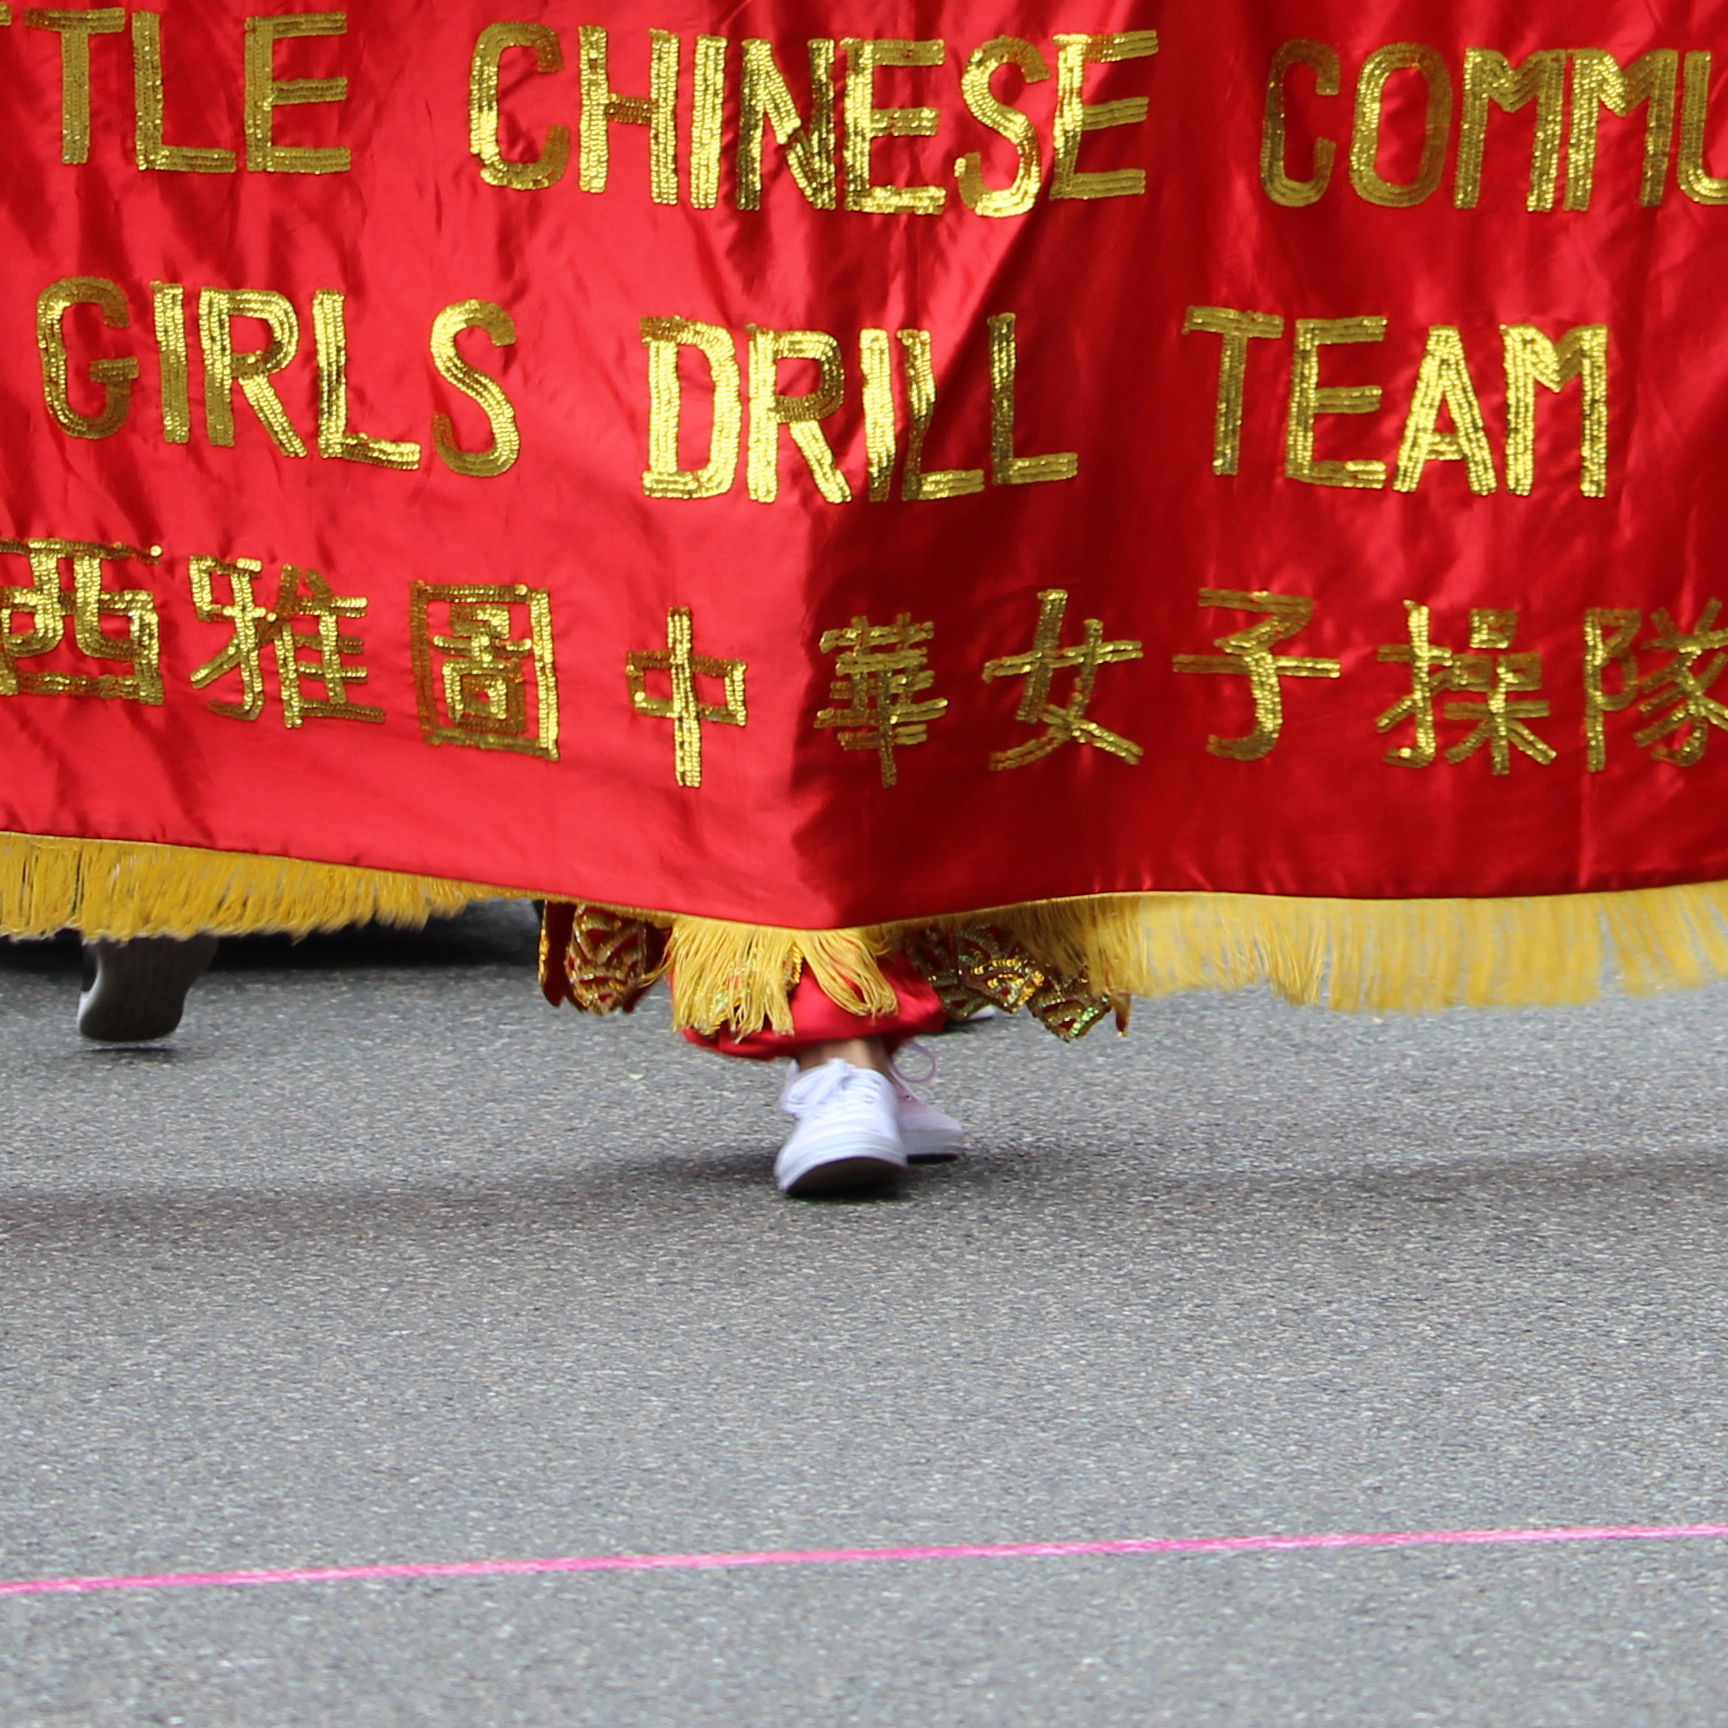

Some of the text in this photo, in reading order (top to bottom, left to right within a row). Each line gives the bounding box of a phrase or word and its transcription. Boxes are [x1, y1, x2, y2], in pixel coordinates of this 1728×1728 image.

[469, 21, 1159, 218] CHINESE
[35, 276, 1609, 504] GIRLS DRILL TEAM
